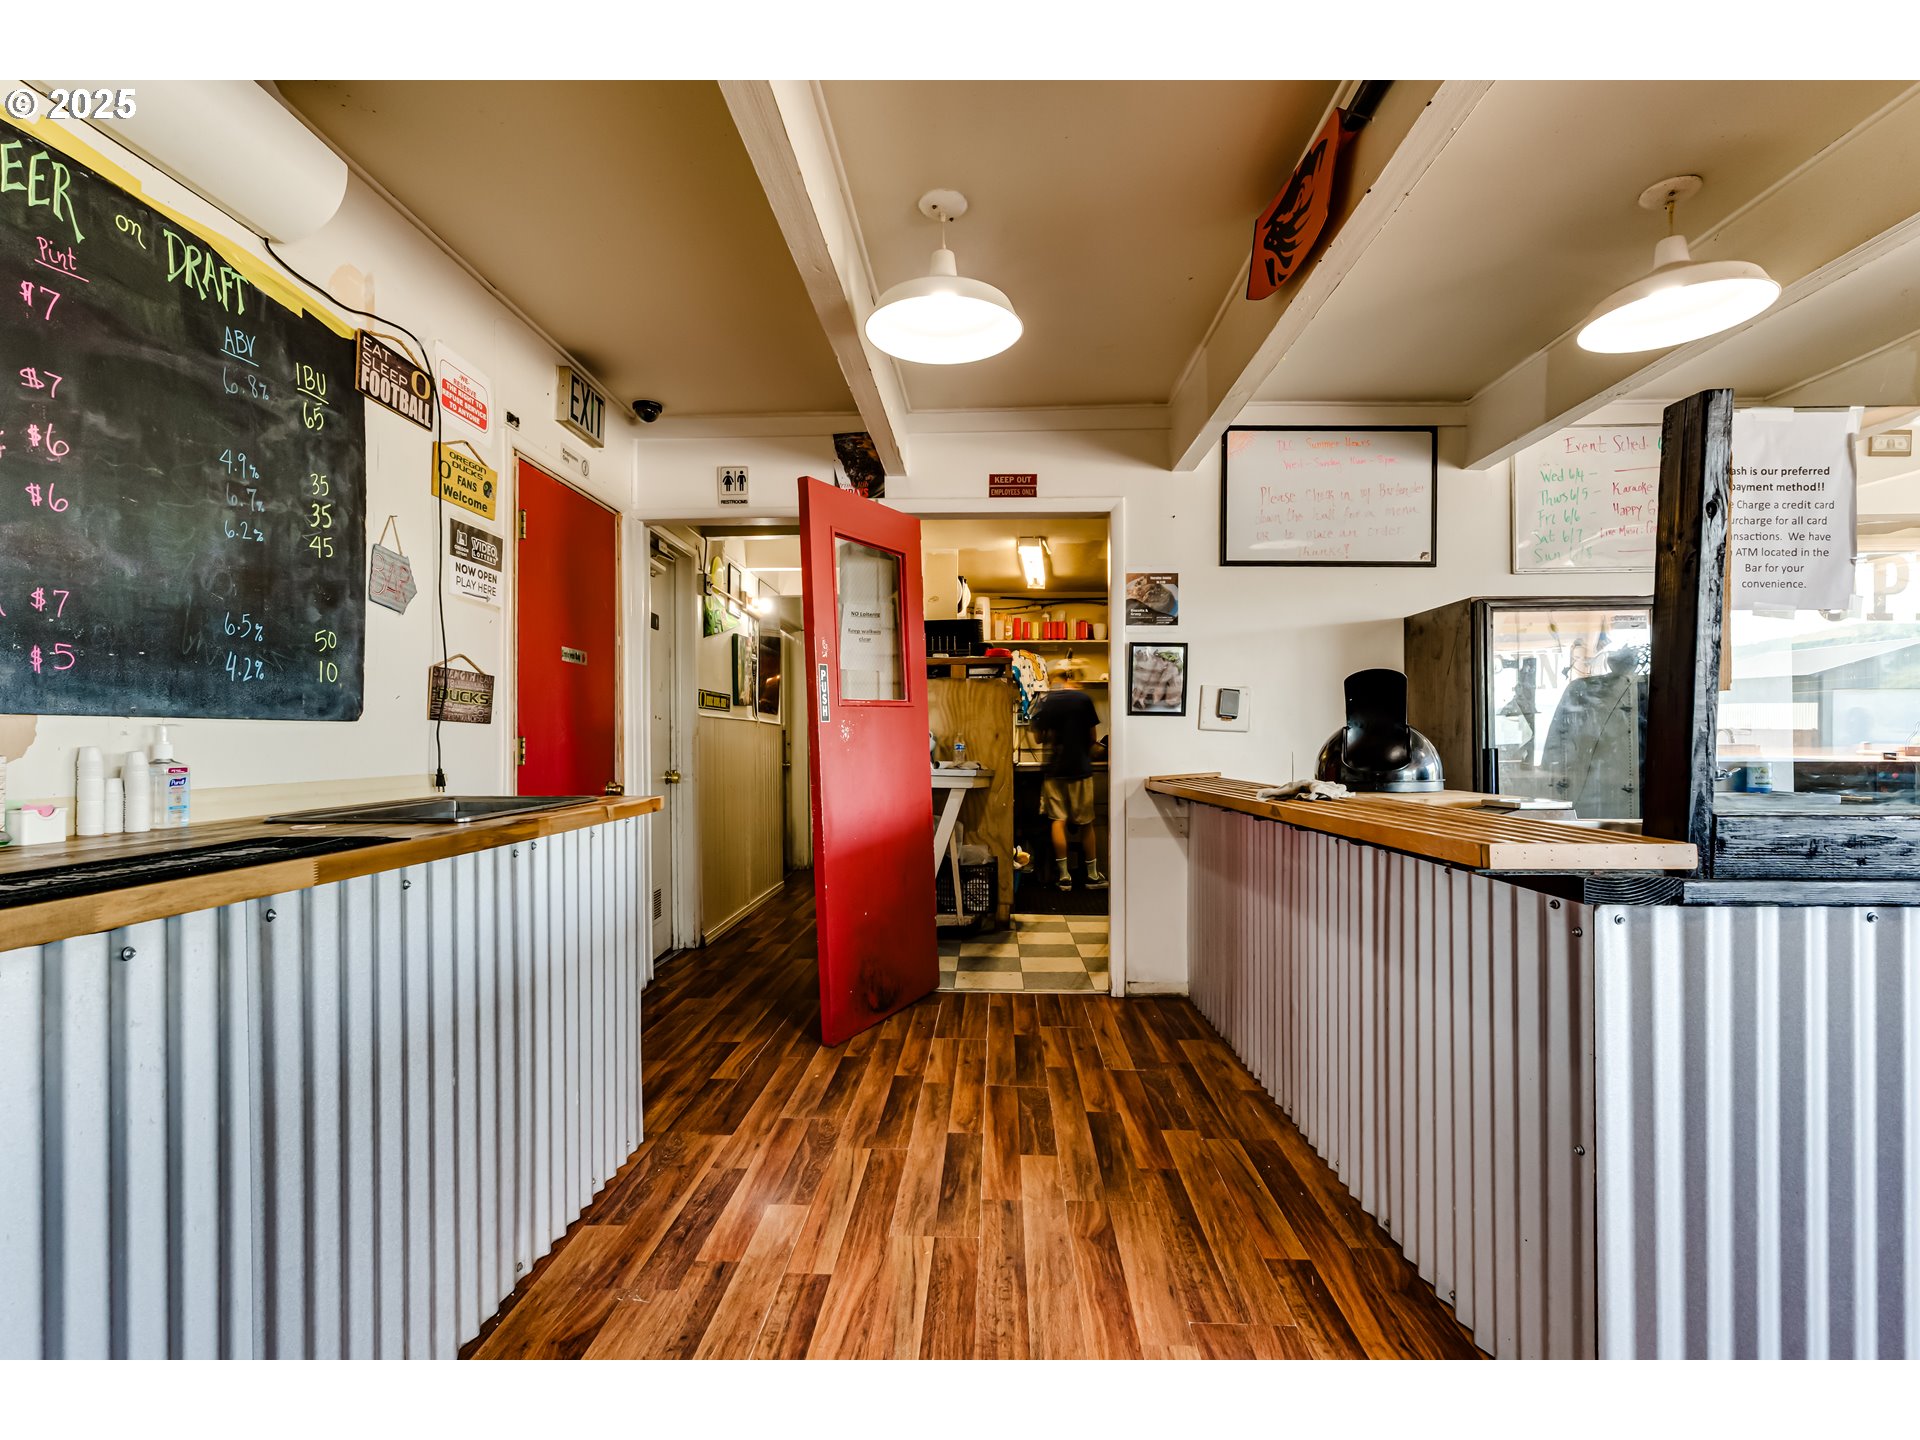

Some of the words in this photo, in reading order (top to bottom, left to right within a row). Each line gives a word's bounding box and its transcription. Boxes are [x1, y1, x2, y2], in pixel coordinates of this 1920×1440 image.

[36, 235, 77, 272] Pint
[115, 213, 147, 250] on
[163, 228, 250, 316] DRAFT
[19, 279, 61, 321] $7
[223, 326, 257, 359] ABV
[363, 336, 391, 363] EAT
[295, 362, 327, 396] IBU
[361, 351, 409, 387] SLEEP
[19, 367, 64, 399] $7
[453, 377, 477, 399] RESERVE
[361, 364, 432, 429] FOOTBALL
[442, 388, 464, 407] REFUSE
[463, 402, 487, 421] SERVICE
[445, 381, 457, 394] THE
[457, 388, 475, 405] RIGHT
[474, 400, 483, 410] TO
[570, 373, 605, 440] EXIT
[303, 402, 325, 431] 65
[448, 401, 457, 411] TO
[457, 407, 481, 425] ANYONE
[27, 423, 70, 458] $6
[1306, 436, 1340, 449] Summer
[1563, 435, 1608, 454] Event
[449, 451, 487, 475] OREGON
[451, 460, 484, 482] DUCKS
[1731, 467, 1747, 476] ash
[1749, 467, 1758, 476] is
[1760, 468, 1778, 476] our
[1781, 467, 1830, 477] preferred
[310, 473, 330, 497] 35
[457, 475, 478, 493] FANS
[994, 476, 1015, 484] KEEP
[1016, 476, 1032, 484] OUT
[1540, 467, 1565, 483] Wed
[1776, 482, 1825, 491] method!!
[25, 483, 69, 513] $6
[443, 483, 488, 513] Welcome
[990, 488, 1021, 496] EMPLOYEES
[1021, 488, 1035, 496] ONLY
[1261, 486, 1296, 505] Please
[1540, 490, 1568, 507] Thurs
[1612, 482, 1654, 496] Karaoke
[310, 503, 333, 529] 35
[1736, 500, 1771, 511] Charge
[1774, 501, 1780, 509] a
[1781, 500, 1812, 509] credit
[1814, 500, 1835, 509] card
[1537, 509, 1556, 528] Fri
[1731, 516, 1772, 527] rcharge
[1776, 516, 1789, 525] for
[1792, 516, 1804, 525] all
[1806, 516, 1828, 525] card
[309, 536, 334, 560] 45
[471, 537, 498, 558] VIDEO
[1534, 529, 1556, 546] Sat
[1731, 532, 1783, 541] nsactions.
[1788, 532, 1806, 541] We
[1808, 532, 1832, 541] have
[472, 549, 497, 564] LOTTERY
[1534, 548, 1561, 563] Sun
[1735, 548, 1758, 557] ATM
[1761, 547, 1798, 557] located
[1800, 548, 1810, 557] in
[1812, 548, 1830, 557] the
[455, 561, 477, 577] NOW
[477, 569, 498, 585] OPEN
[1745, 563, 1762, 572] Bar
[1765, 563, 1779, 572] for
[1781, 565, 1805, 574] your
[455, 575, 477, 591] PLAY
[477, 582, 498, 597] HERE
[1741, 580, 1807, 589] convenience.
[30, 587, 70, 618] $7
[224, 612, 264, 642] 6.5%
[314, 630, 338, 653] 50
[30, 643, 76, 674] $5
[225, 651, 265, 682] 4.2%
[319, 660, 338, 683] 10
[437, 688, 490, 705] DUCKS
[820, 668, 829, 717] PUSH
